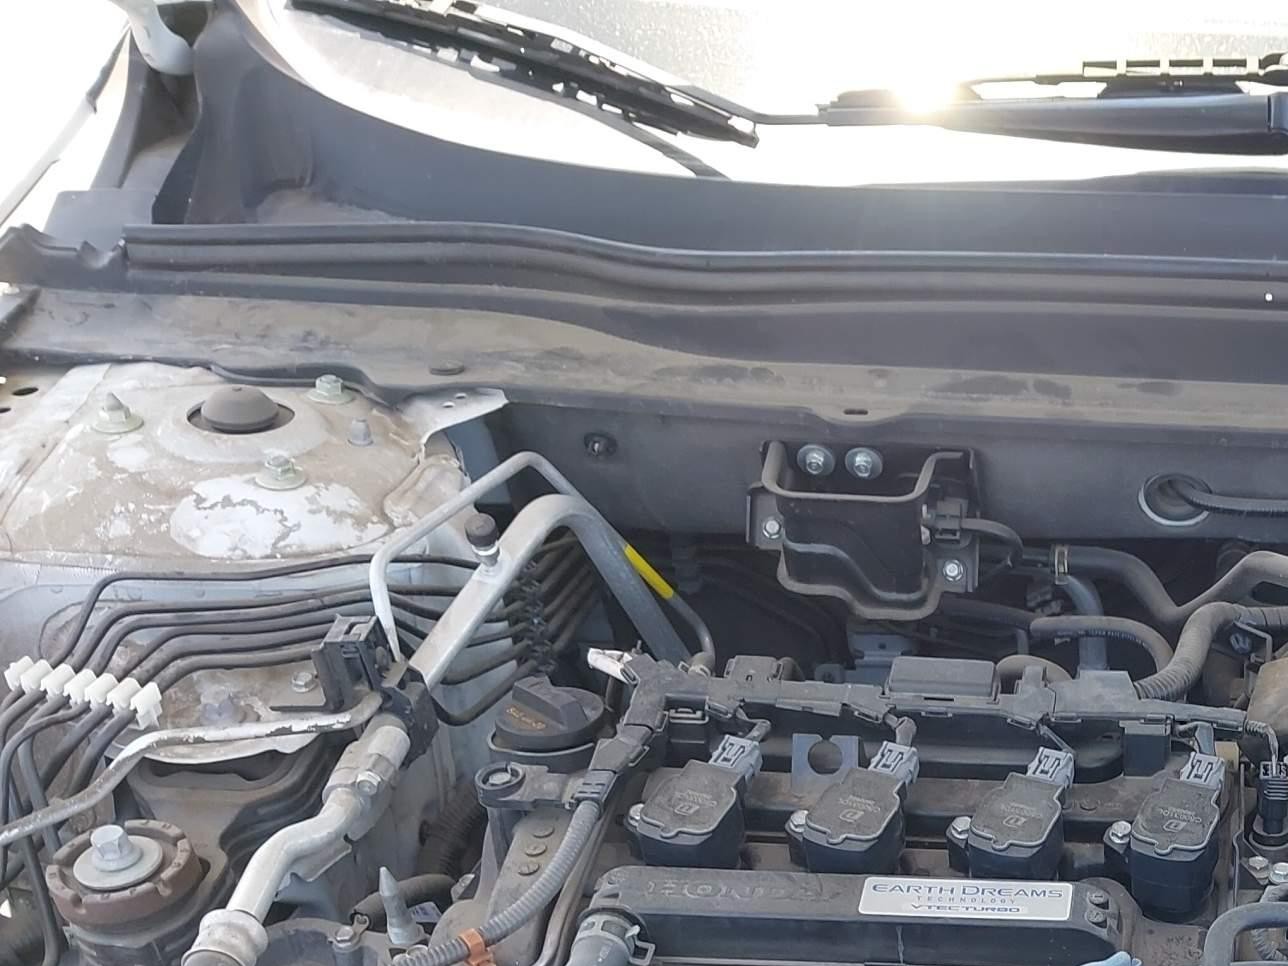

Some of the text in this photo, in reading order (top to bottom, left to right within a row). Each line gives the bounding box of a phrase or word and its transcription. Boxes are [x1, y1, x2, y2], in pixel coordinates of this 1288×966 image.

[872, 883, 1063, 899] EARTH DREAMS
[917, 895, 1016, 905] TECHNOLOGY
